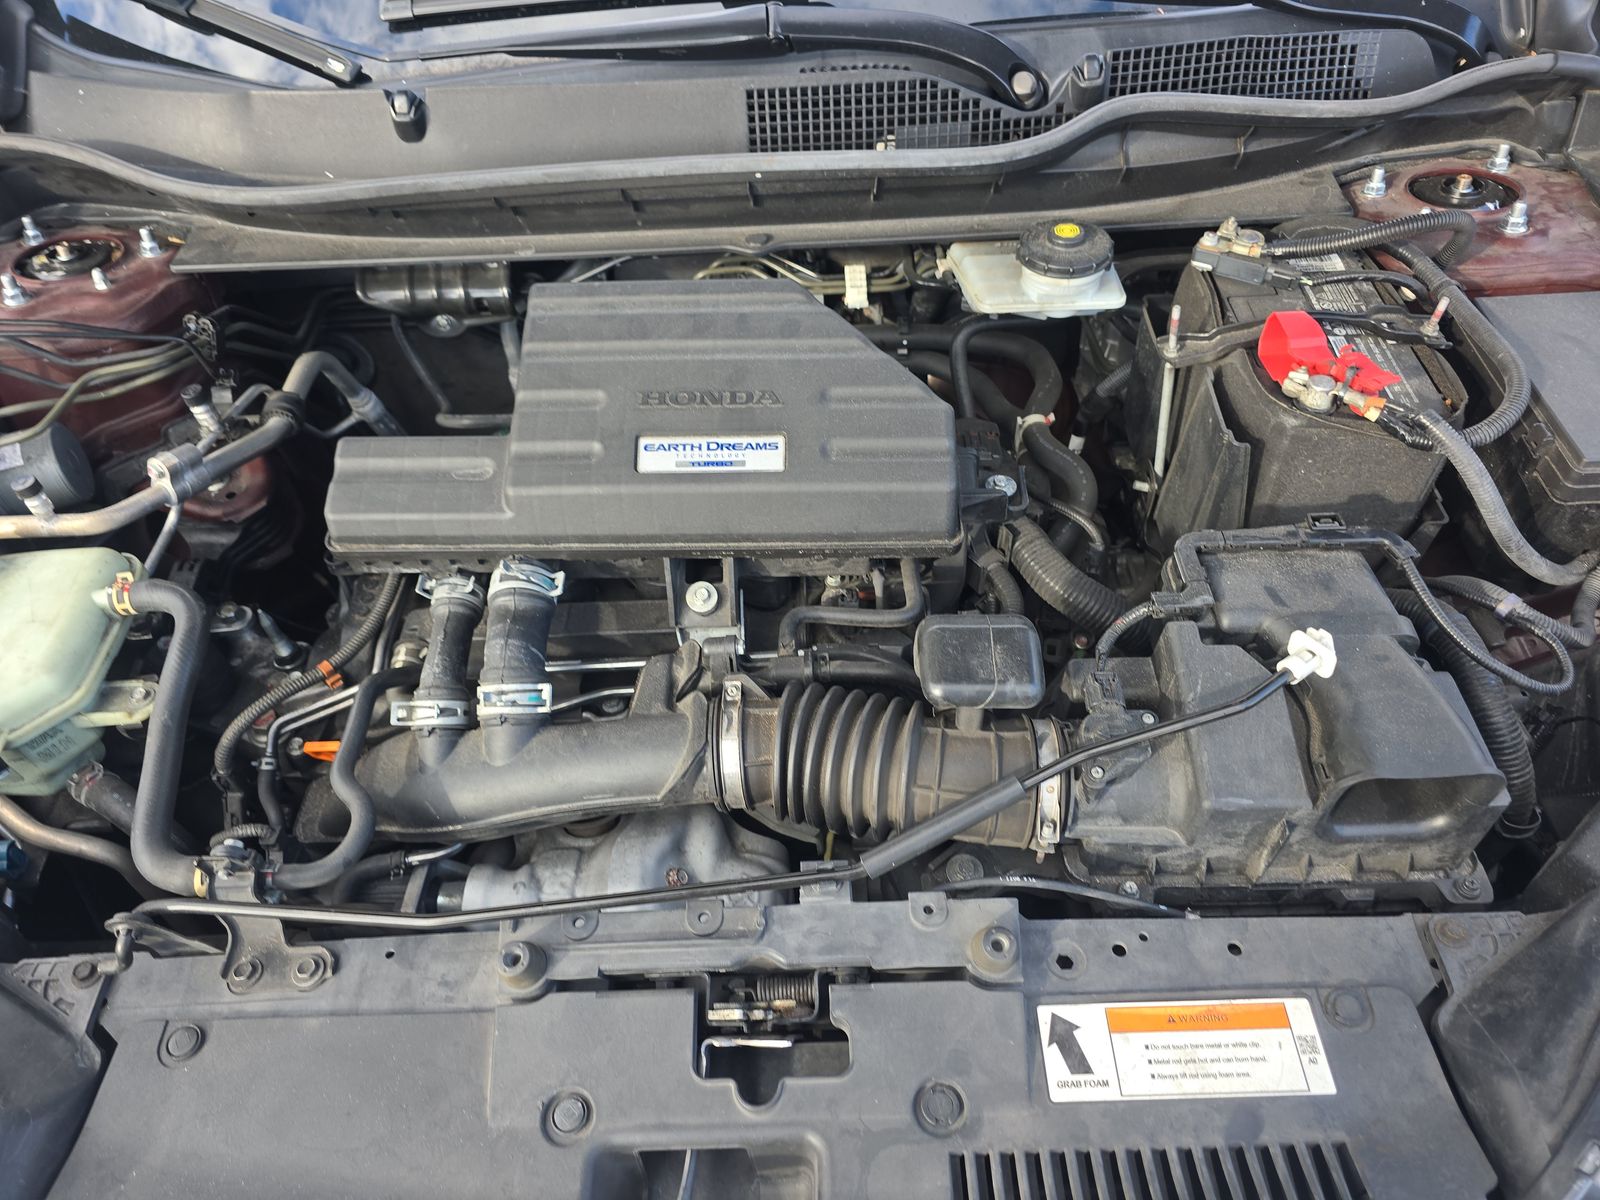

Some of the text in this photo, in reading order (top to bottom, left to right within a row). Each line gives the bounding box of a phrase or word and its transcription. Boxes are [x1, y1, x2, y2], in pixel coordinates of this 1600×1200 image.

[637, 389, 785, 408] HONDA
[643, 441, 780, 452] EARTH DREAMS
[1178, 1014, 1229, 1023] WARNING
[1183, 1058, 1197, 1066] gets
[1157, 1072, 1179, 1081] Always
[1200, 1071, 1217, 1080] using
[1218, 1070, 1234, 1078] foam
[1056, 1079, 1110, 1089] GRAB FOAM
